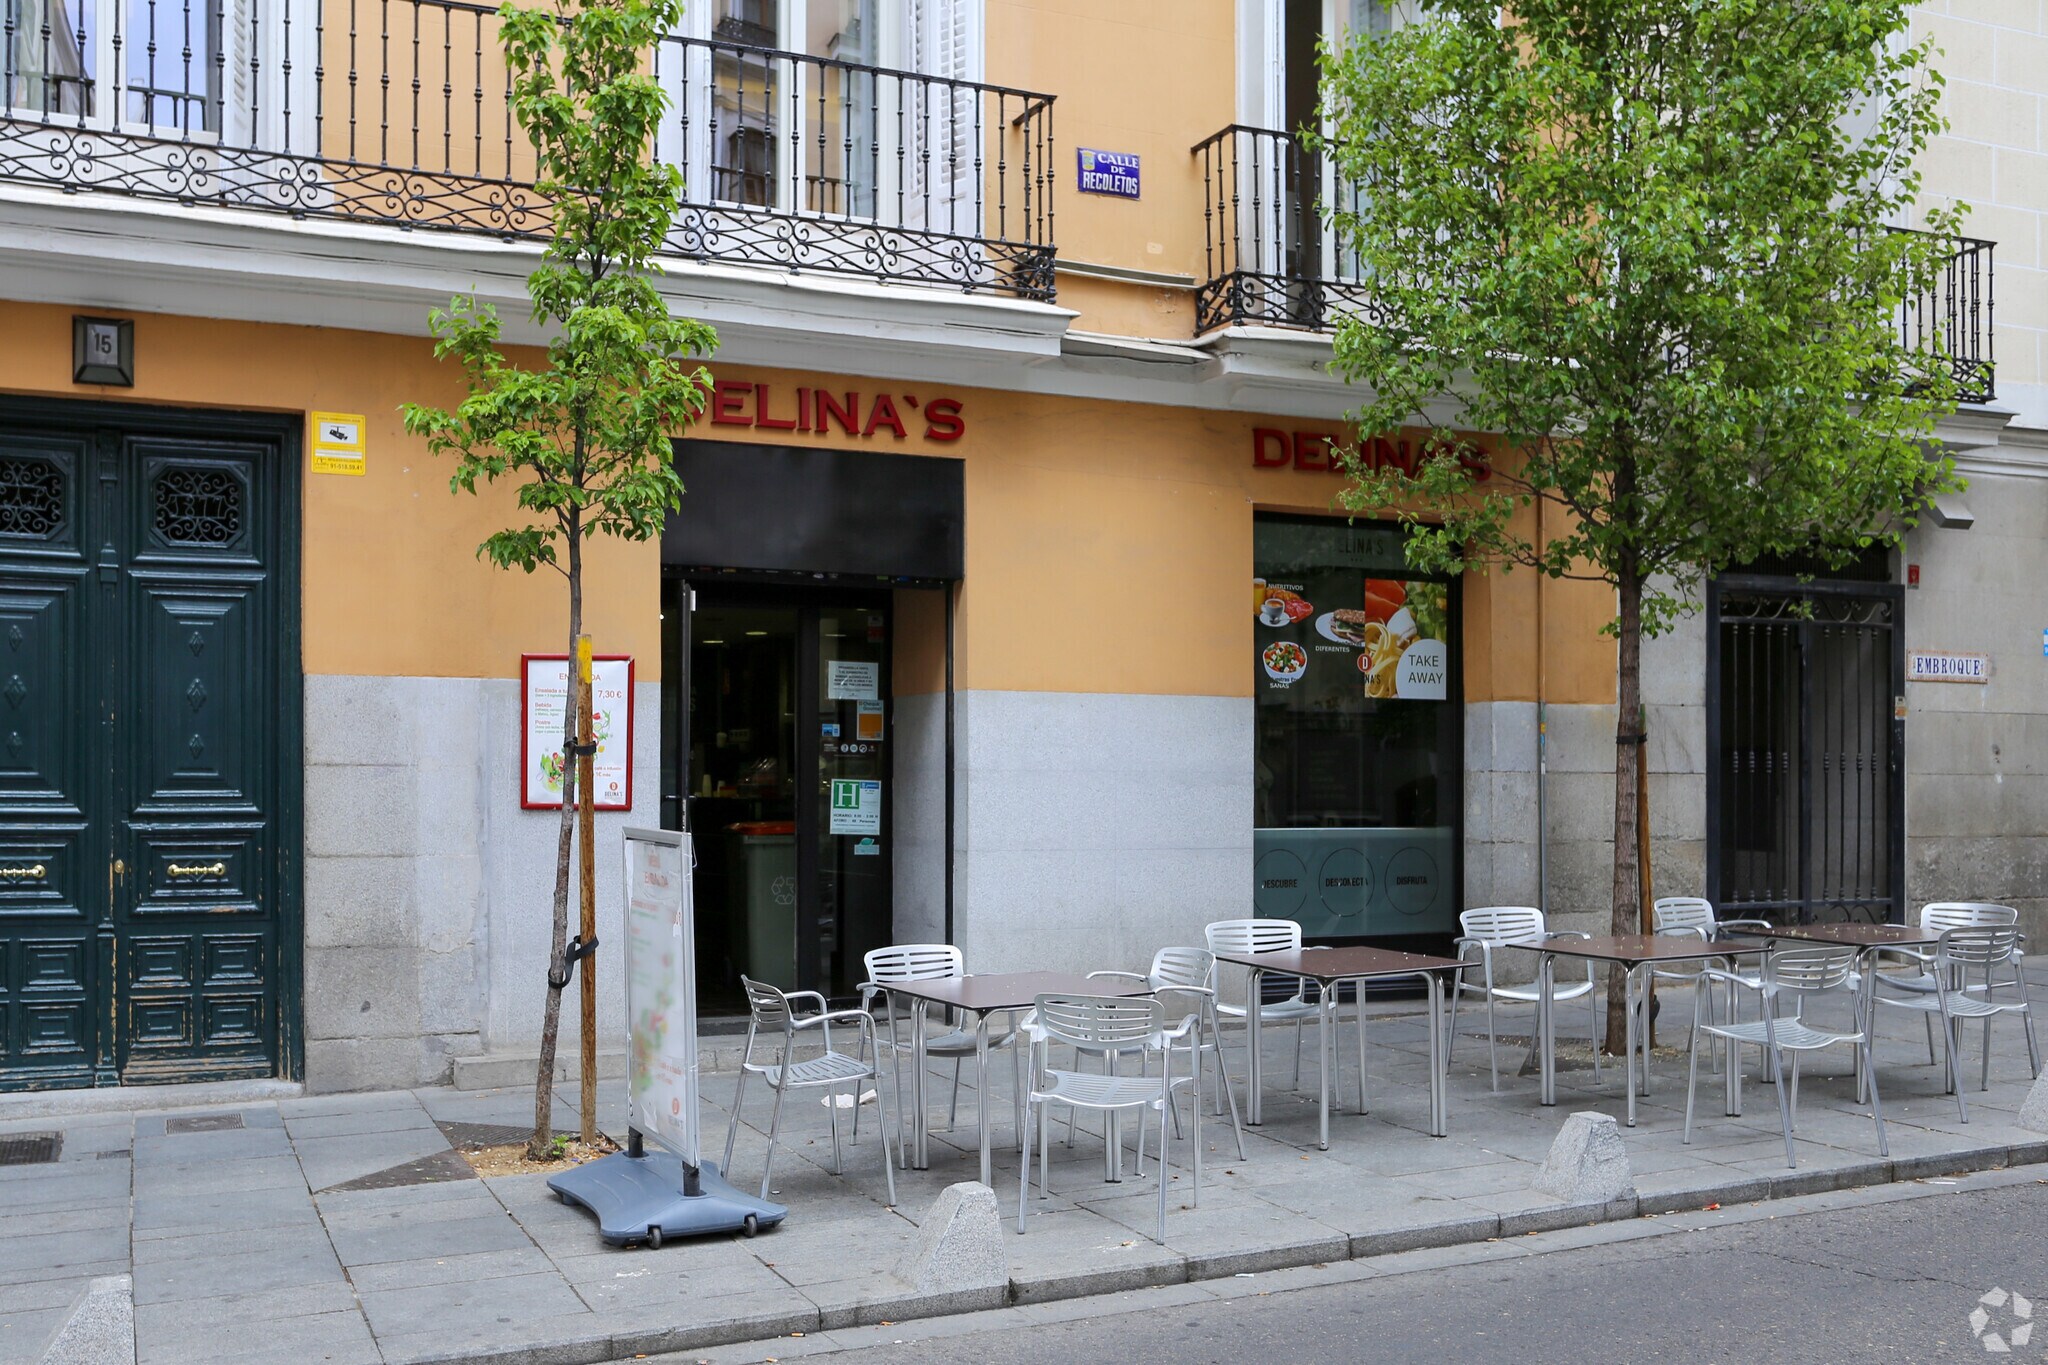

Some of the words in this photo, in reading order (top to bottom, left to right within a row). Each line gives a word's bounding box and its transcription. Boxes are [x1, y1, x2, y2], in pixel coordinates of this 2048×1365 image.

[1097, 153, 1139, 168] CALLE
[1110, 165, 1126, 175] DE
[1083, 171, 1138, 195] RECOLETOS
[95, 333, 112, 354] 15
[1268, 583, 1304, 591] NUTRITIVOS
[1315, 645, 1350, 653] DIFERENTES
[1408, 654, 1439, 667] TAKE
[1916, 657, 1981, 676] EMBROQUE
[1408, 671, 1443, 684] AWAY
[597, 689, 615, 699] 7,30
[616, 690, 622, 699] €
[835, 782, 860, 808] H
[1396, 875, 1428, 886] DISFRUTA
